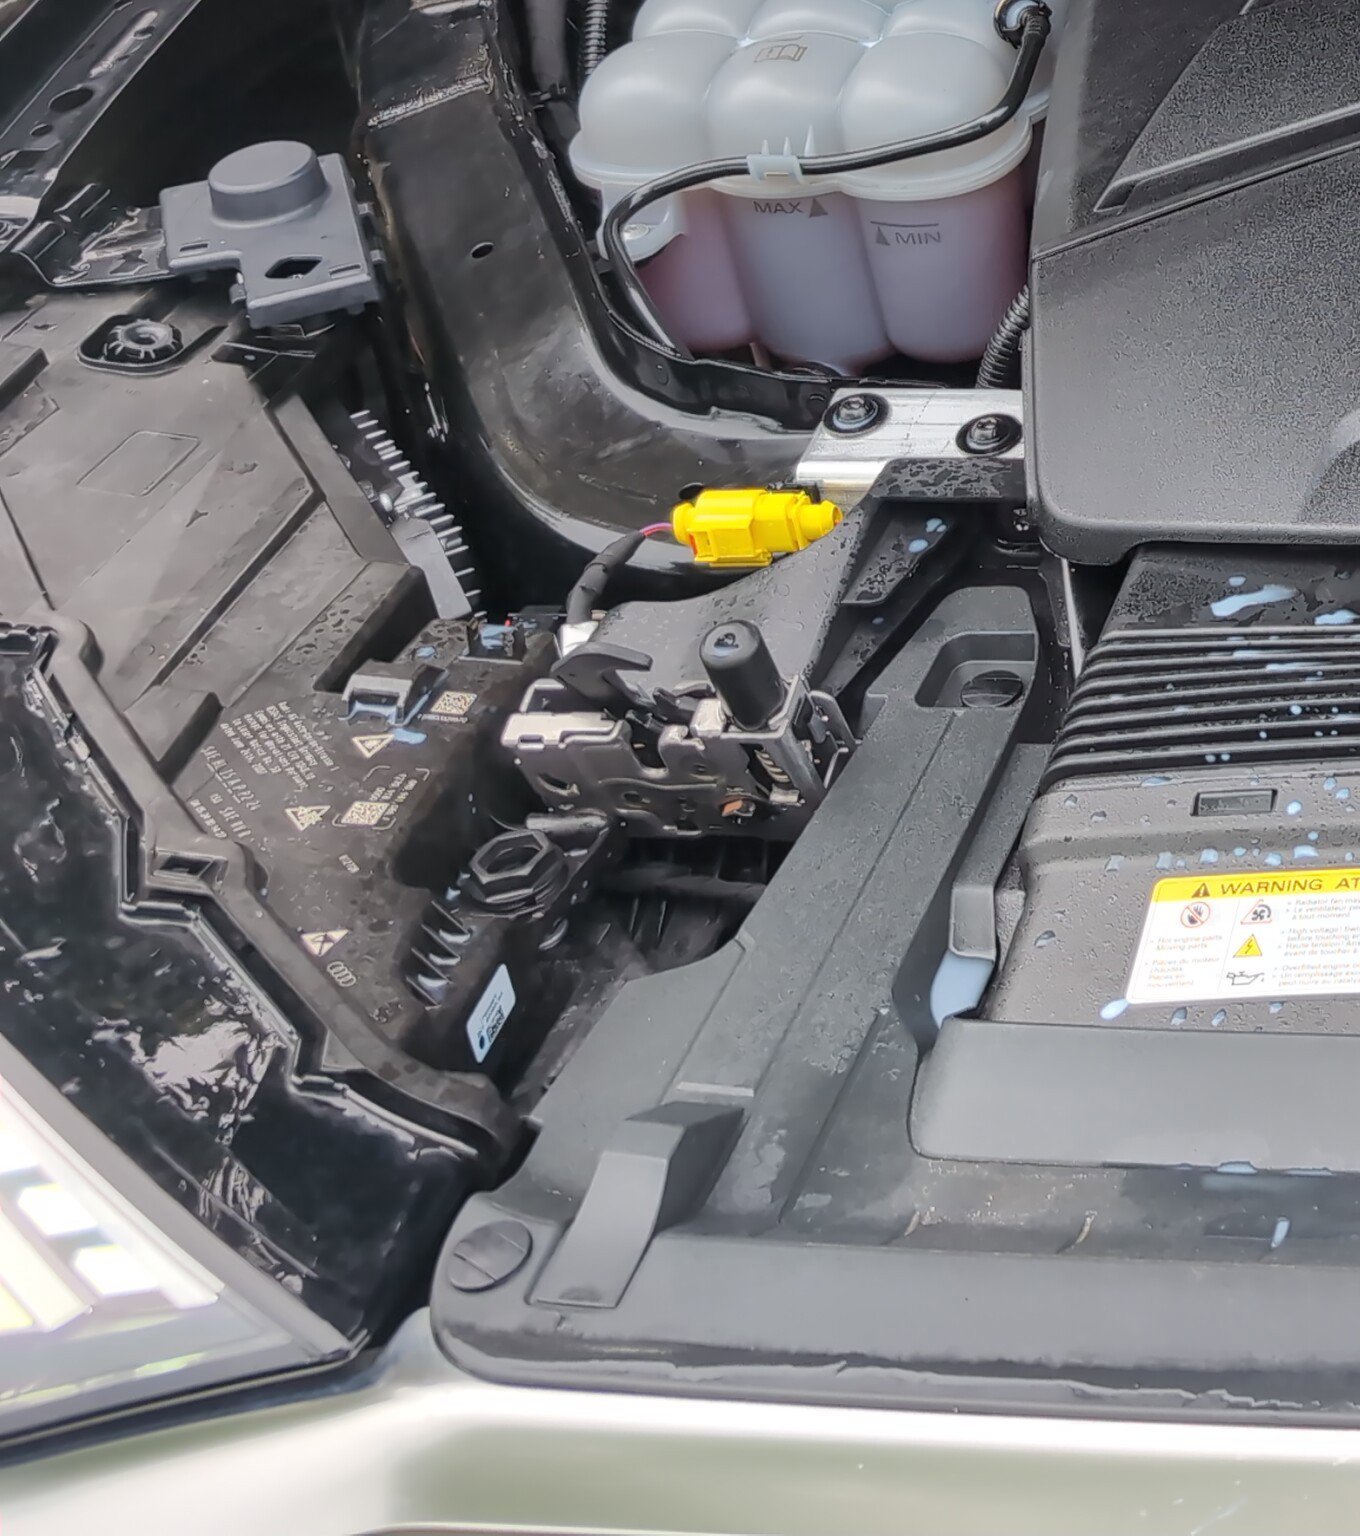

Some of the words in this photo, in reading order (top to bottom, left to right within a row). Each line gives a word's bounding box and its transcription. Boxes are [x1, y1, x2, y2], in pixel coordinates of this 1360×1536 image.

[753, 200, 803, 215] MAX
[895, 230, 942, 245] MIN
[1220, 878, 1323, 895] WARNING
